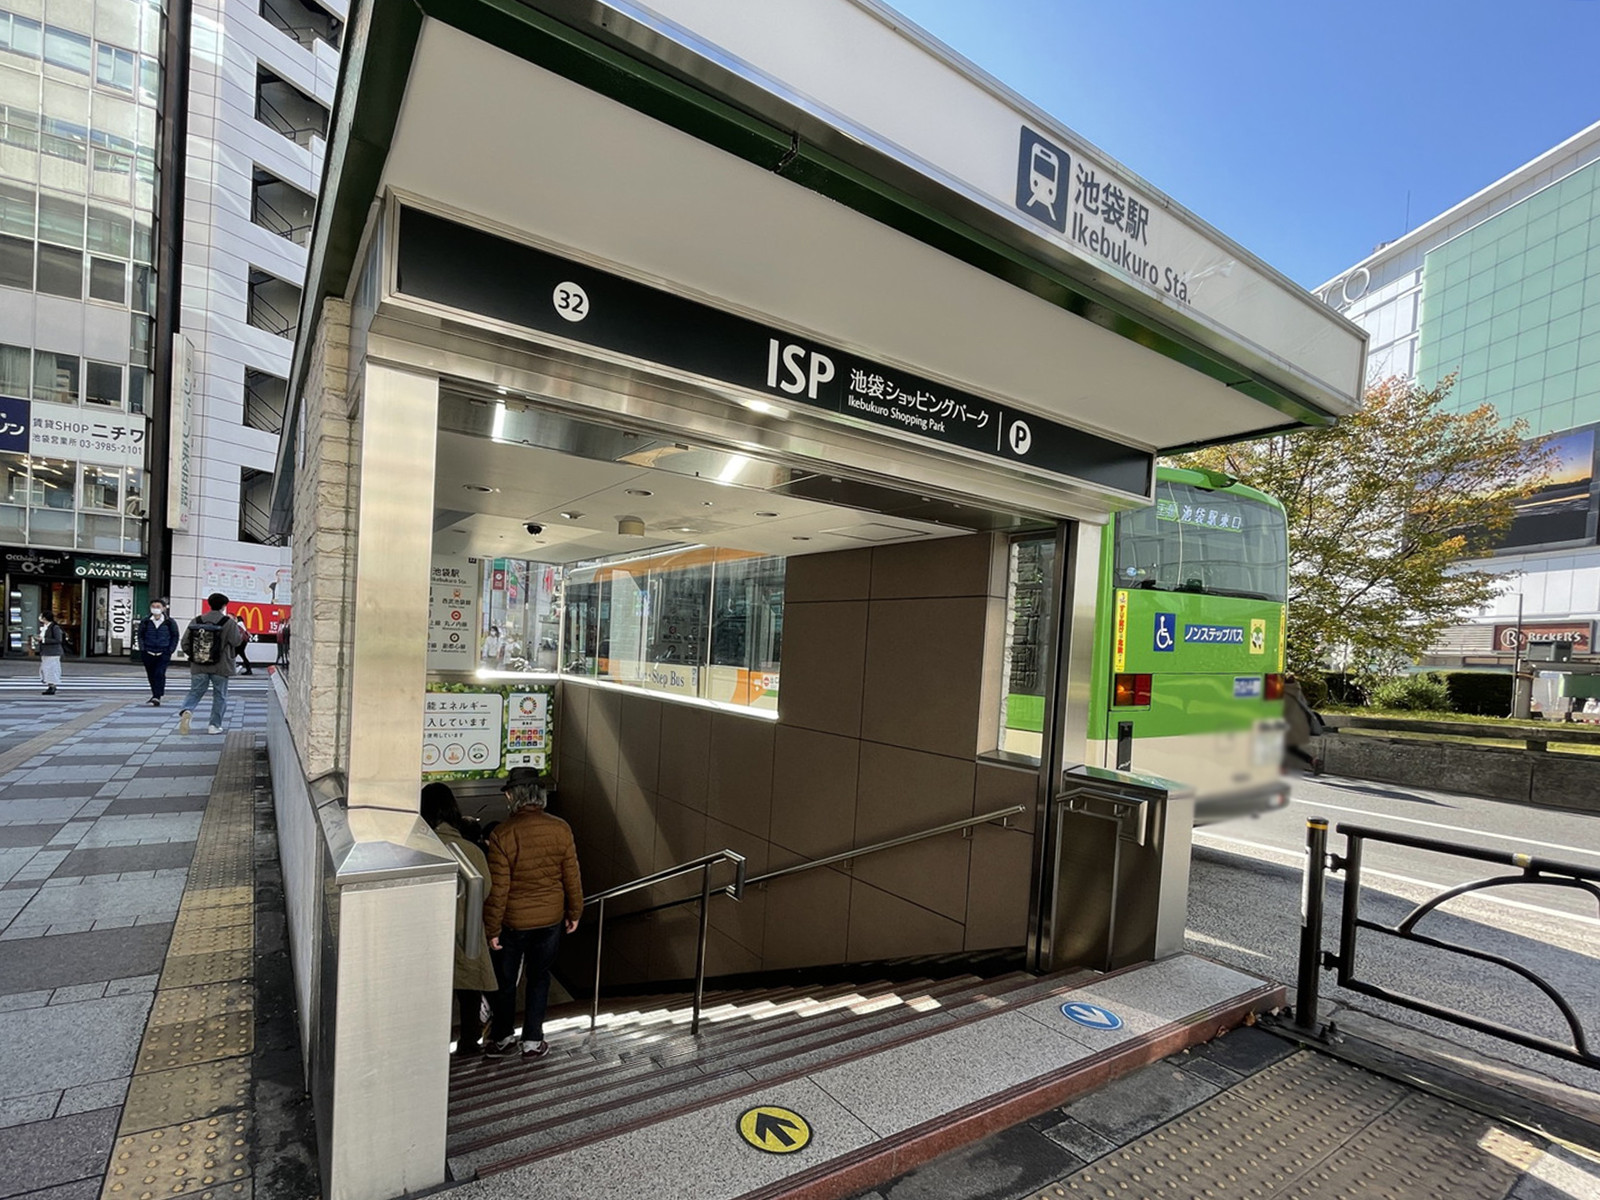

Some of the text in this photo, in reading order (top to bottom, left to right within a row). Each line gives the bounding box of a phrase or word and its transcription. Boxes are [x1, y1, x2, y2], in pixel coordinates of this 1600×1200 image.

[1074, 163, 1149, 247] 池袋駅
[1072, 211, 1192, 305] Ikebukuro Sta.
[558, 289, 584, 314] 32
[766, 338, 835, 400] ISP
[849, 368, 989, 428] 池袋ショッピングパーク
[848, 394, 945, 433] Ikebukuro Shopping Park
[92, 424, 144, 443] ニチワ
[32, 434, 142, 455] 池袋営業所 03-3985-2101
[1181, 504, 1242, 529] 池袋駅東口
[87, 568, 132, 578] AVANTI
[433, 567, 460, 578] 池袋駅
[1184, 626, 1244, 642] ノンステップバス
[670, 670, 685, 687] Bus
[427, 701, 488, 711] 能エネルギー
[427, 717, 488, 728] 入しています
